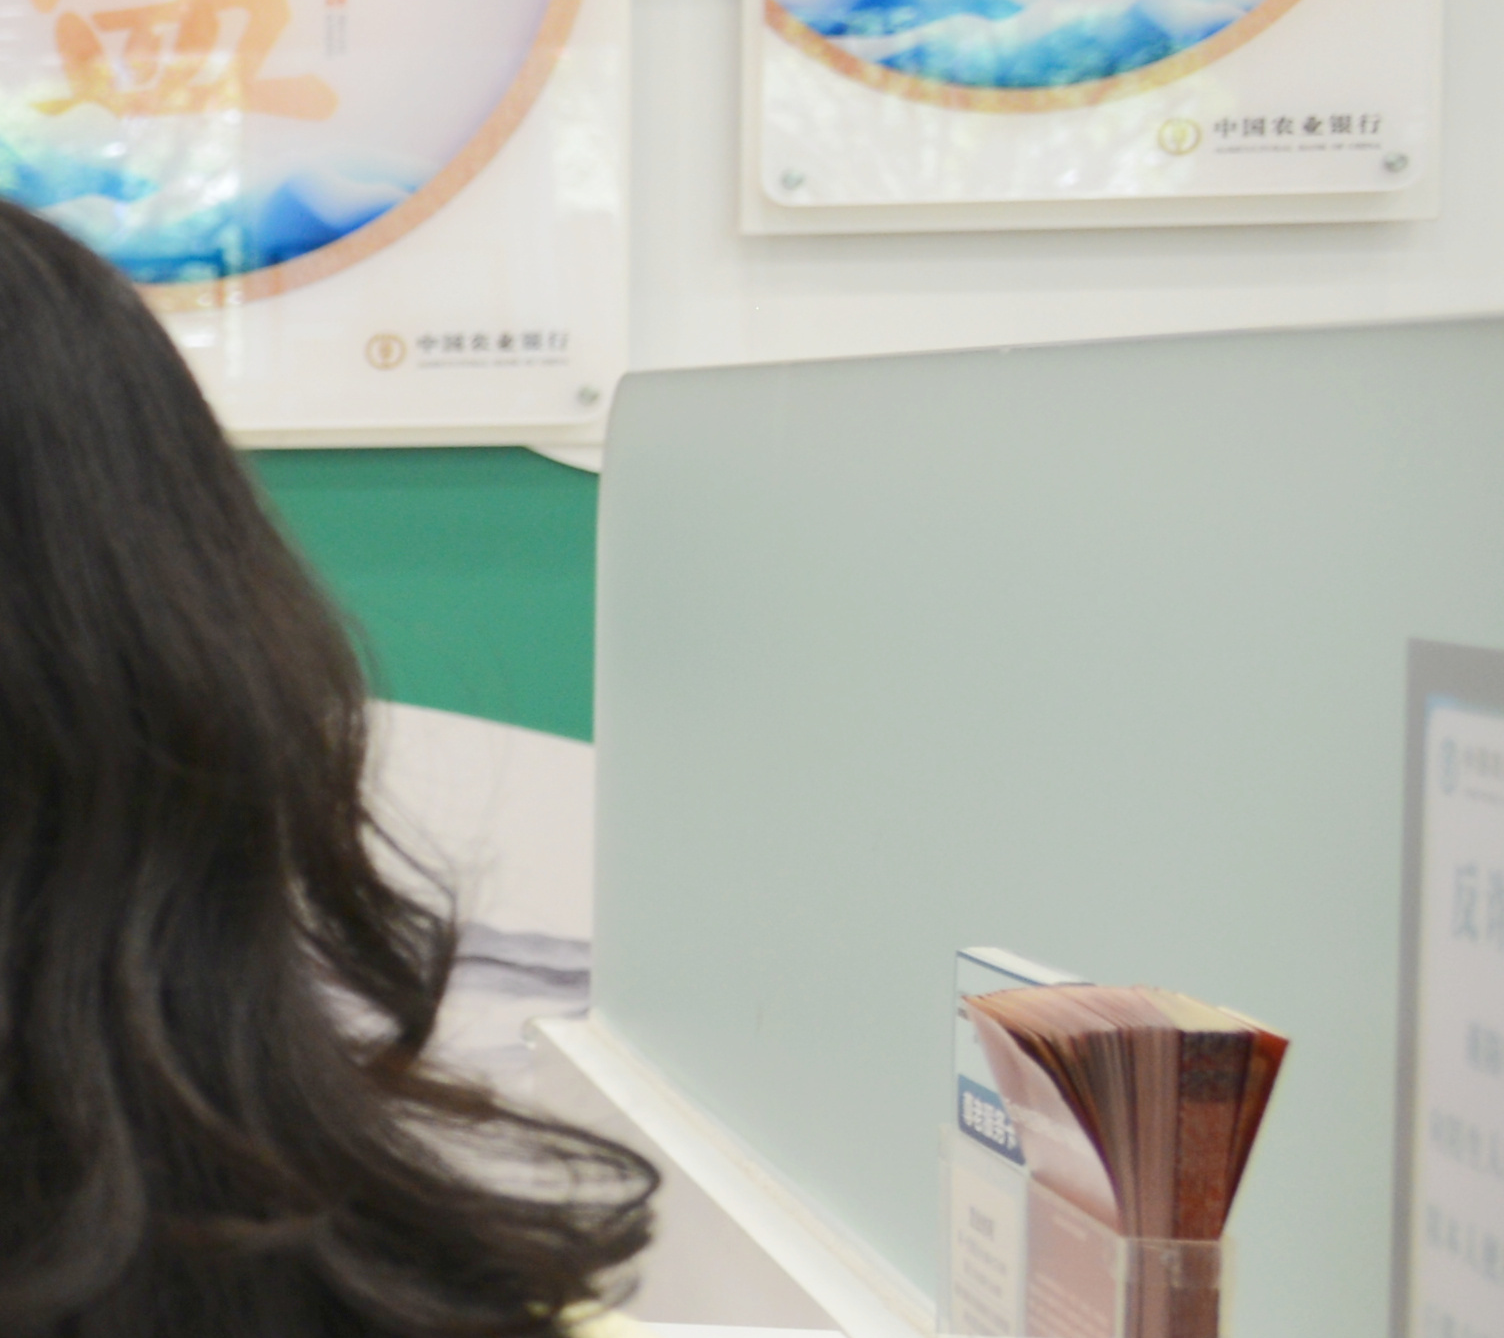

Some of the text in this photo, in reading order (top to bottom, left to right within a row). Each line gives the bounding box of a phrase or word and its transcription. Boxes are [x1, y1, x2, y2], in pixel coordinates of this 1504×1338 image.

[1213, 113, 1383, 141] 中国农业银行
